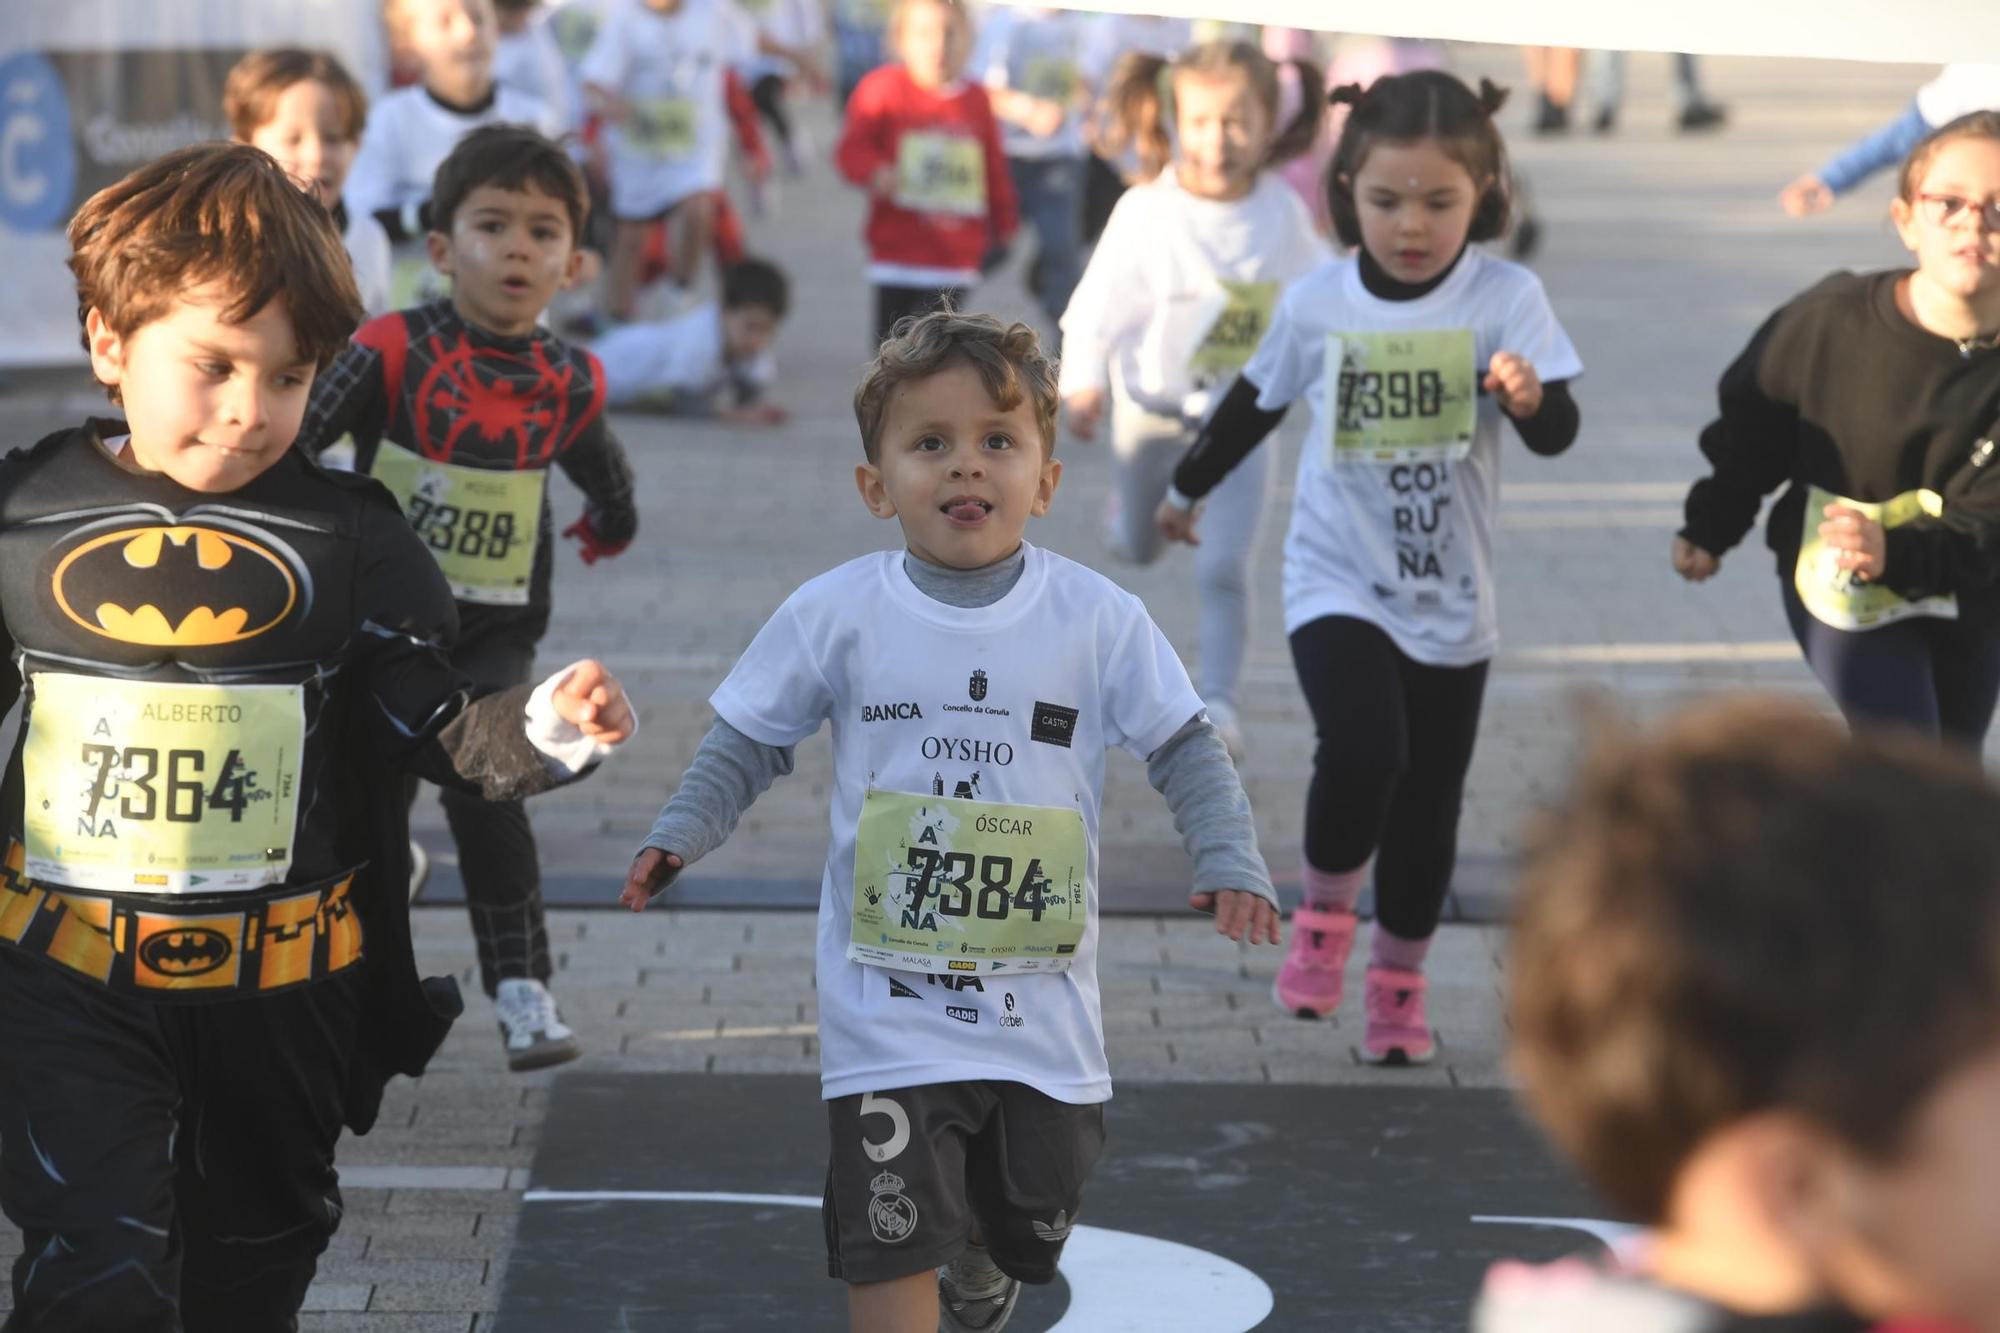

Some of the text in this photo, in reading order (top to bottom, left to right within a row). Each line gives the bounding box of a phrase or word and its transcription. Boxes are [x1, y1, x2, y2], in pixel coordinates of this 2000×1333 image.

[1389, 464, 1437, 492] CO
[1393, 505, 1438, 533] RU
[142, 704, 242, 724] ALBERTO
[862, 703, 923, 723] BANCA
[942, 703, 1010, 717] Concello da Coruña
[1041, 715, 1069, 730] CASTRO
[921, 736, 1014, 766] OYSHO
[82, 742, 248, 823] 7364
[918, 825, 938, 845] A
[975, 814, 1033, 836] ÓSCAR
[906, 847, 1047, 922] 7384
[1073, 882, 1082, 905] 7384
[949, 962, 976, 970] GADIS
[947, 1008, 977, 1022] GADIS
[859, 1092, 911, 1163] 5
